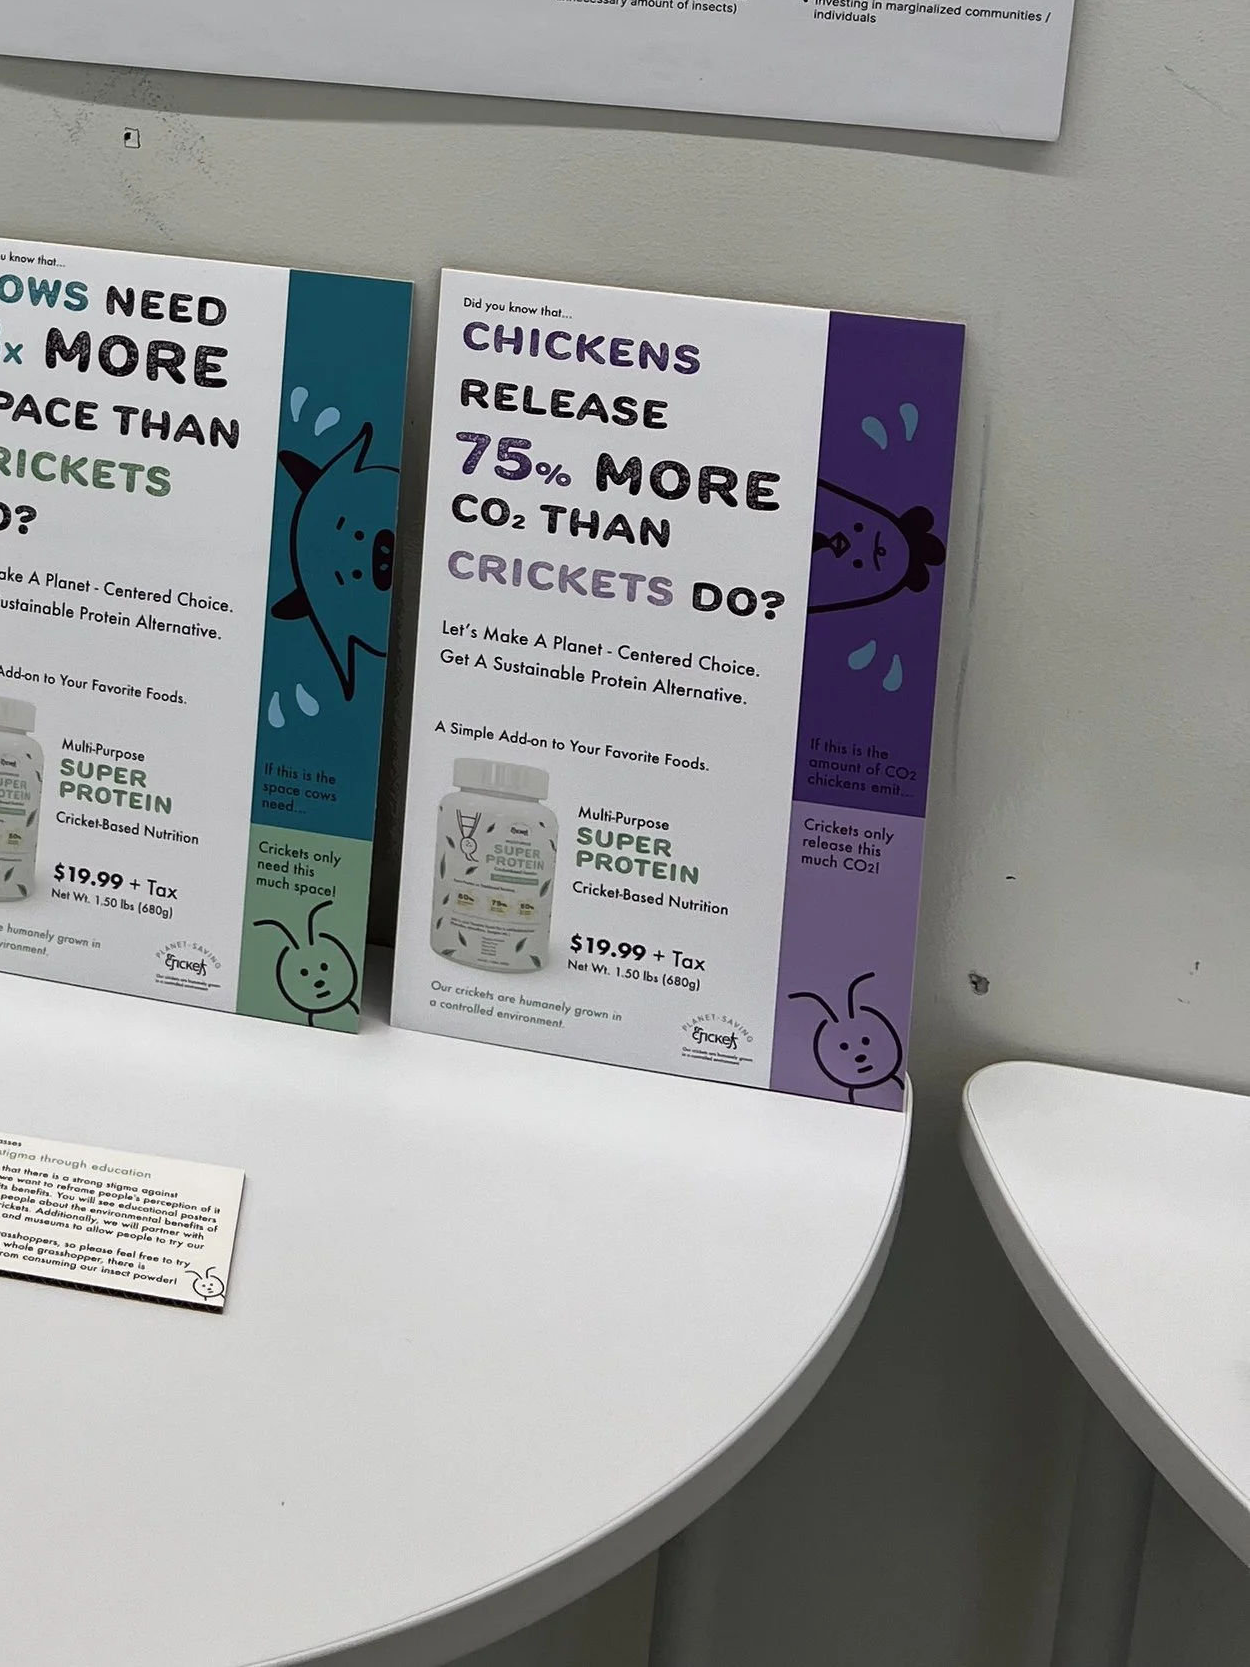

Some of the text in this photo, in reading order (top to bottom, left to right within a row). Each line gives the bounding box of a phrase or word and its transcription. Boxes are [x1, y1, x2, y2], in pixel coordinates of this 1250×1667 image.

[106, 286, 226, 326] NEED
[464, 297, 482, 309] Did
[486, 303, 505, 313] you
[509, 301, 537, 314] know
[45, 327, 228, 388] MORE
[463, 321, 700, 375] CHICKENS
[461, 379, 668, 429] RELEASE
[113, 405, 239, 449] THAN
[456, 431, 780, 511] 75% MORE
[540, 504, 670, 548] THAN
[448, 550, 785, 620] CRICKETS DO?
[62, 738, 144, 761] Multi-Purpose
[577, 827, 671, 858] SUPER
[576, 850, 698, 884] PROTEIN
[570, 933, 646, 961] $19.99
[673, 950, 705, 971] Tax
